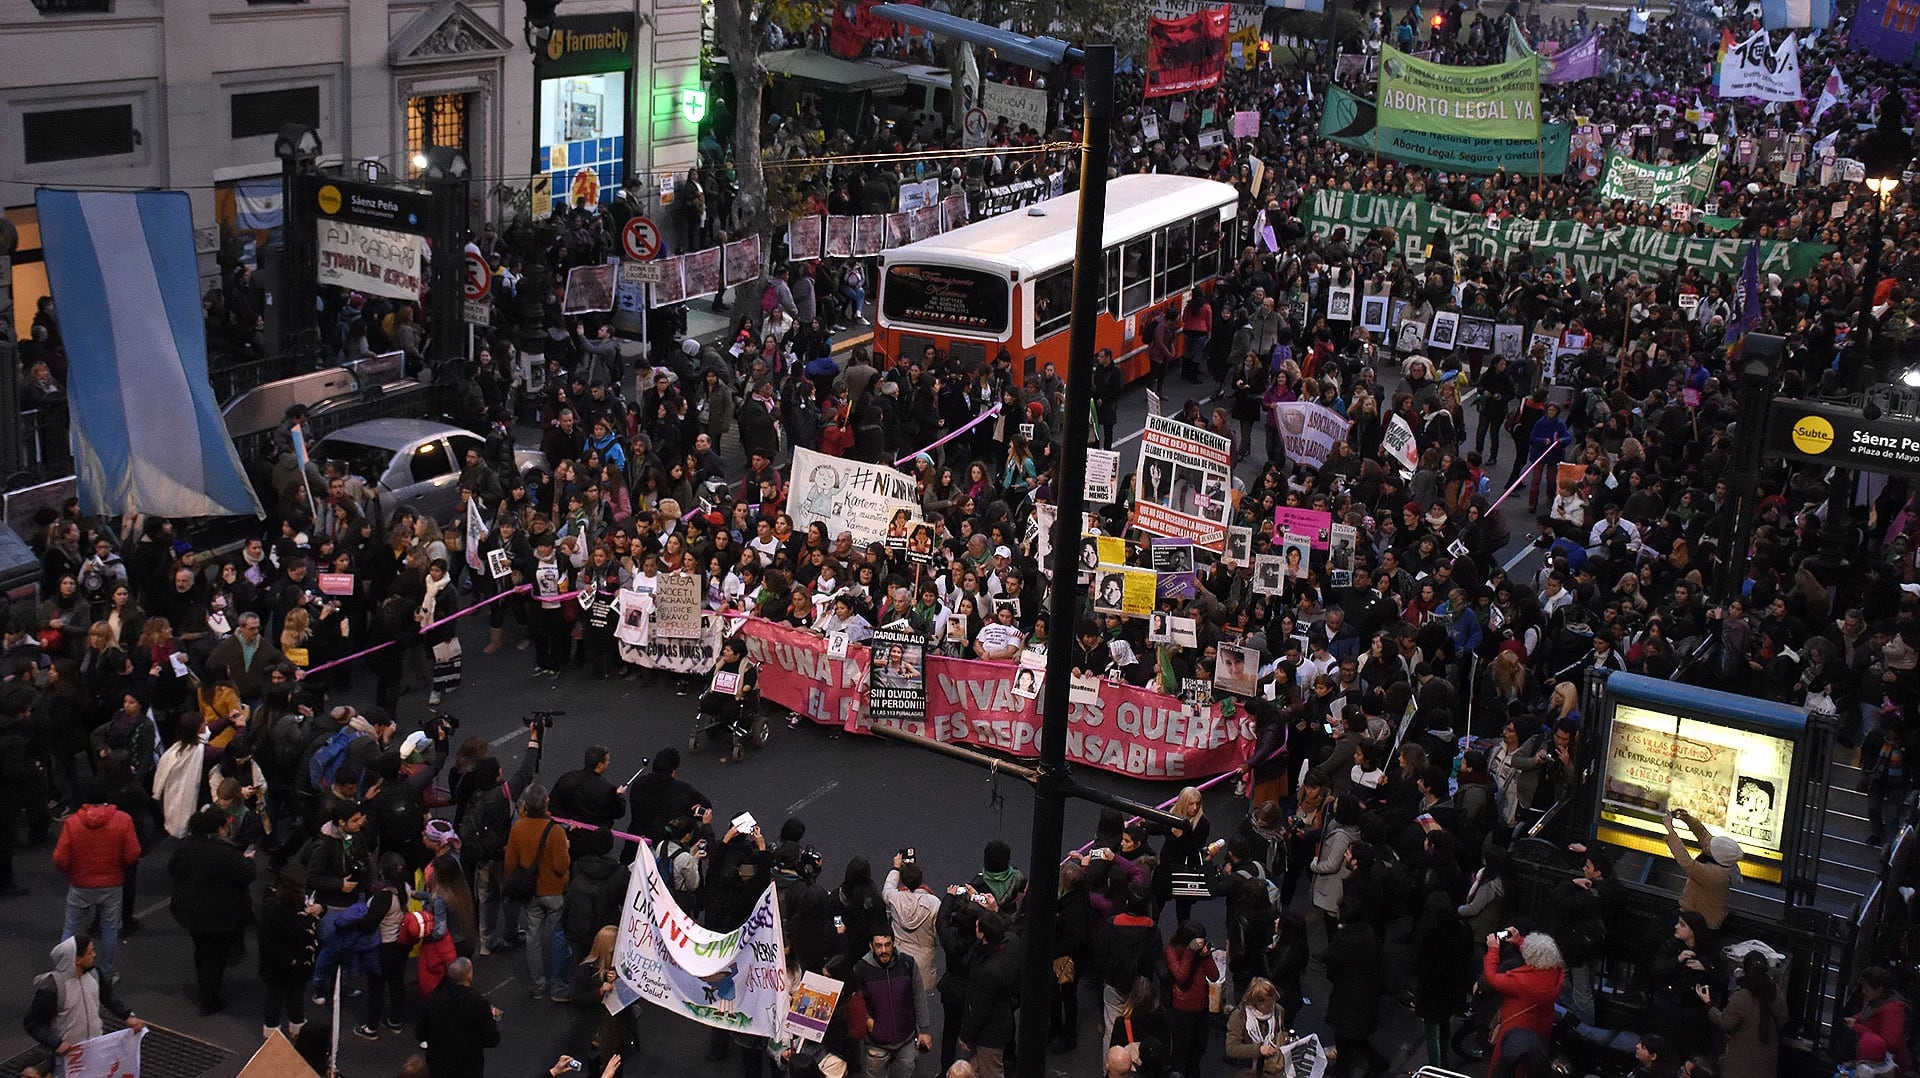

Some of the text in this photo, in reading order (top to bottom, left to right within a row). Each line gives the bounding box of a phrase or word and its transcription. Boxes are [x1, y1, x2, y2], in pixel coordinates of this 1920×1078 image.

[566, 27, 629, 52] farmacity
[1384, 89, 1534, 120] ABORTO LEGAL YA
[1392, 138, 1425, 154] Aborto
[1459, 153, 1493, 164] Seguro
[1474, 137, 1490, 147] por
[351, 195, 376, 208] Sáenz
[377, 199, 400, 212] Peña
[1351, 193, 1418, 231] UNA
[1504, 217, 1626, 251] MUJER
[628, 264, 657, 273] ZONA DE
[904, 308, 988, 326] ESCOLARES
[1150, 418, 1228, 452] ROMINA MENEGHINI
[1798, 427, 1828, 440] Subte
[1852, 430, 1898, 449] Sáenz
[1147, 433, 1159, 441] ASI
[1160, 436, 1170, 446] ME
[1171, 438, 1187, 451] DEJO
[1188, 443, 1199, 453] MI
[1857, 446, 1881, 457] Plaza
[1882, 450, 1894, 459] de
[1895, 452, 1920, 463] Mayo
[1089, 492, 1109, 500] MENOS
[1096, 485, 1109, 493] UNA
[873, 630, 925, 644] CAROLINA ALO
[745, 634, 773, 664] NI
[775, 643, 832, 686] UNA
[871, 688, 925, 701] SIN OLVIDO...
[871, 700, 926, 710] NI PERDON!!!
[808, 687, 831, 721] EL
[934, 711, 968, 742] ES
[1626, 734, 1709, 760] LAS VILLAS GRITAMOS
[1627, 751, 1673, 769] PATRIARCADO
[1674, 763, 1683, 772] AL
[1685, 766, 1718, 782] CARAJO!
[628, 915, 653, 948] DEJA
[643, 984, 663, 999] Salud
